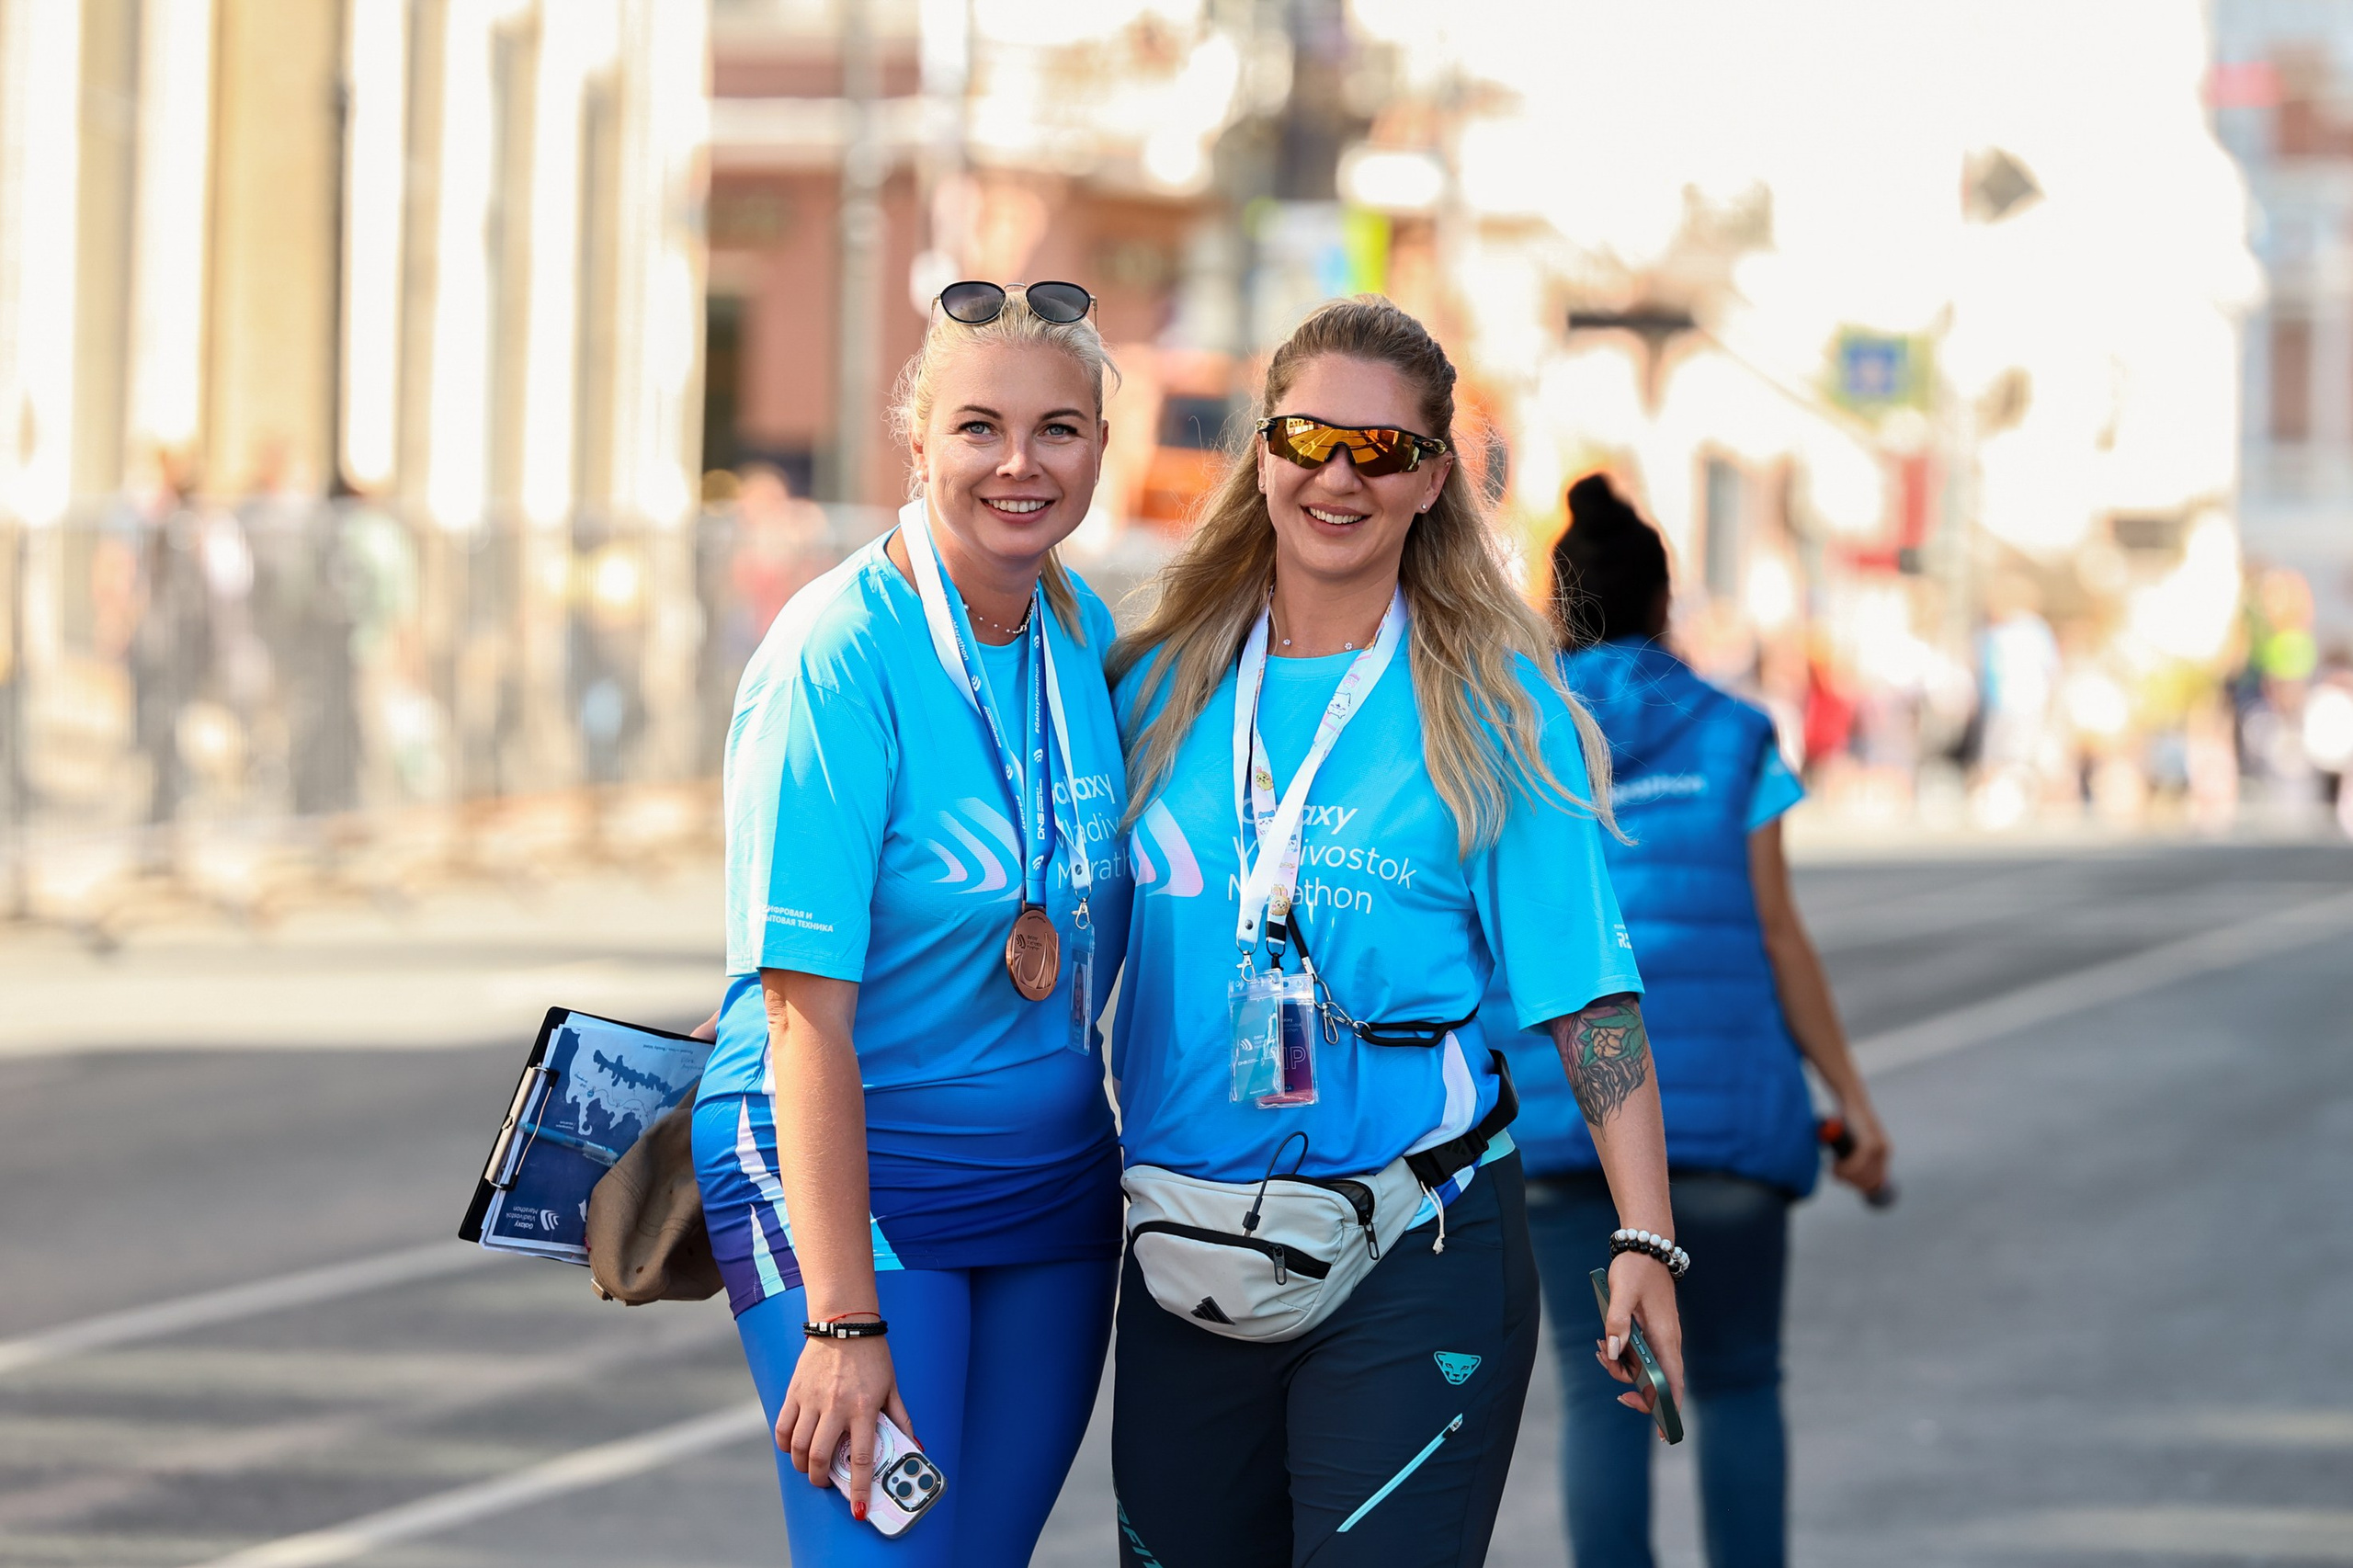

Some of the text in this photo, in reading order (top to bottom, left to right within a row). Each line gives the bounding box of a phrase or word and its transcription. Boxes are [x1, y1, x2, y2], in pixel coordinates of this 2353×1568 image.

[944, 590, 970, 661] Marathon
[1051, 773, 1116, 805] alaxy
[1016, 794, 1028, 833] #Galaxy
[1037, 812, 1046, 840] DNS
[1243, 798, 1358, 835] axy
[1057, 847, 1131, 890] Mrath
[1232, 835, 1417, 890] Vivostok
[1227, 873, 1373, 915] athon
[763, 915, 834, 933] ЫТОВАЯ ТЕХНИКА
[512, 1205, 539, 1215] Marathon
[514, 1220, 534, 1230] Galaxy
